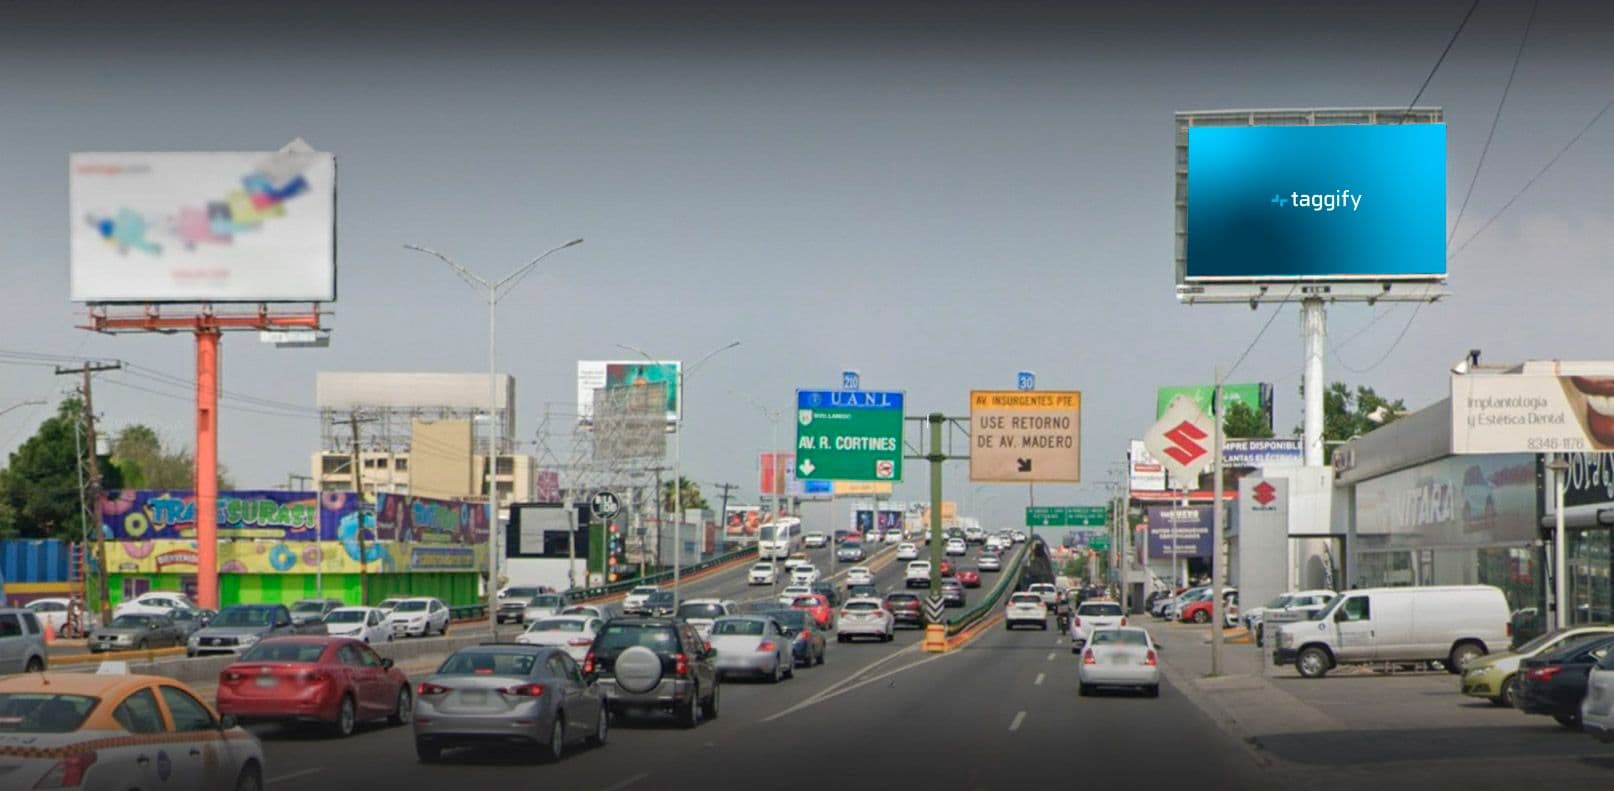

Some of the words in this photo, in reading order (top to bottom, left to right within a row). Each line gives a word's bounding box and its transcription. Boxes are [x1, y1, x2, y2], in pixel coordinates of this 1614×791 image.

[1290, 189, 1362, 211] taggify
[1020, 376, 1033, 388] 30
[991, 396, 1054, 406] INSURGENTES
[980, 416, 1005, 429] USE
[1012, 416, 1070, 430] RETORNO
[1528, 411, 1566, 425] Dental
[799, 436, 816, 449] AV.
[819, 436, 831, 449] R.
[835, 436, 896, 451] CORTINES
[977, 435, 993, 448] DE
[999, 435, 1016, 448] AV.
[1021, 435, 1073, 448] MADERO
